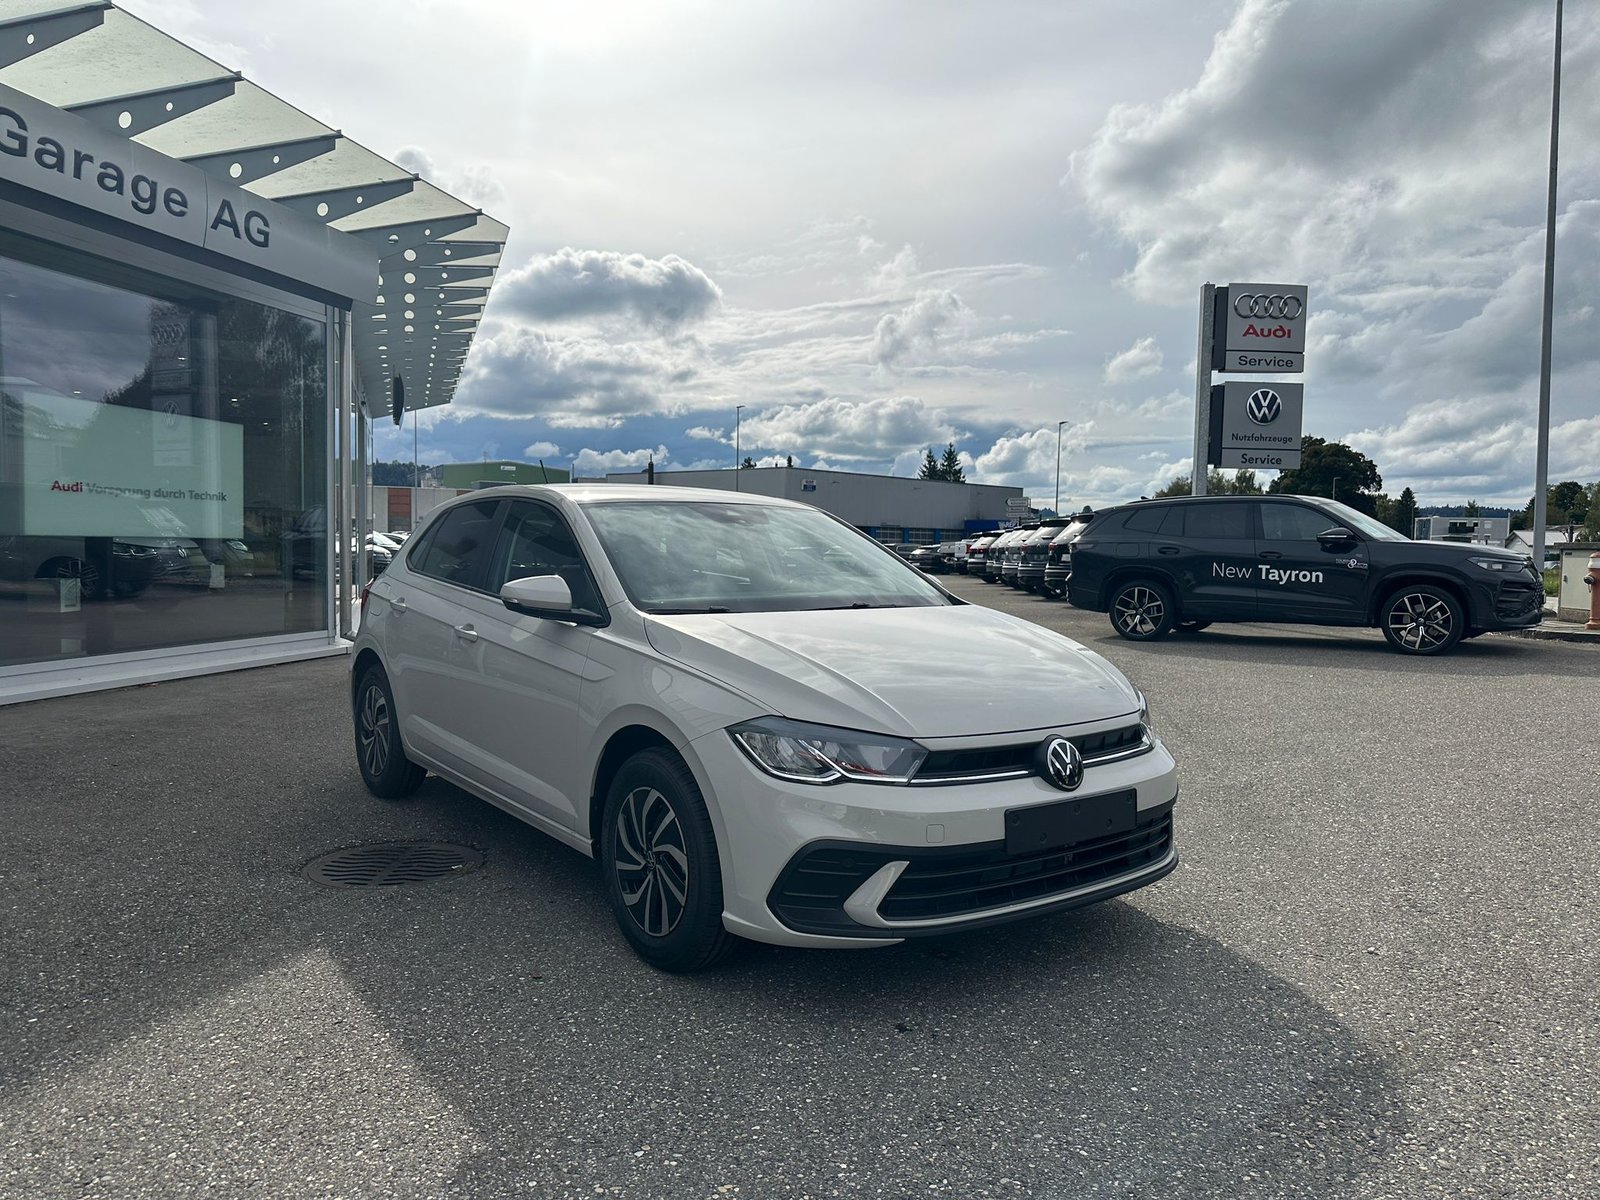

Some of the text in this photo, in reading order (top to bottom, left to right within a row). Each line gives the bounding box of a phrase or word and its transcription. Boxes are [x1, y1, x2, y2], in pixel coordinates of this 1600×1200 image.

[0, 106, 271, 248] Garage AG
[1242, 324, 1292, 339] Audi
[1238, 355, 1294, 368] Service
[1231, 433, 1293, 444] Nutzfahrzeuge
[1241, 453, 1282, 465] Service
[51, 480, 83, 492] Audi
[153, 487, 186, 499] durch
[188, 489, 227, 501] Technik
[1212, 562, 1323, 585] New Tayron
